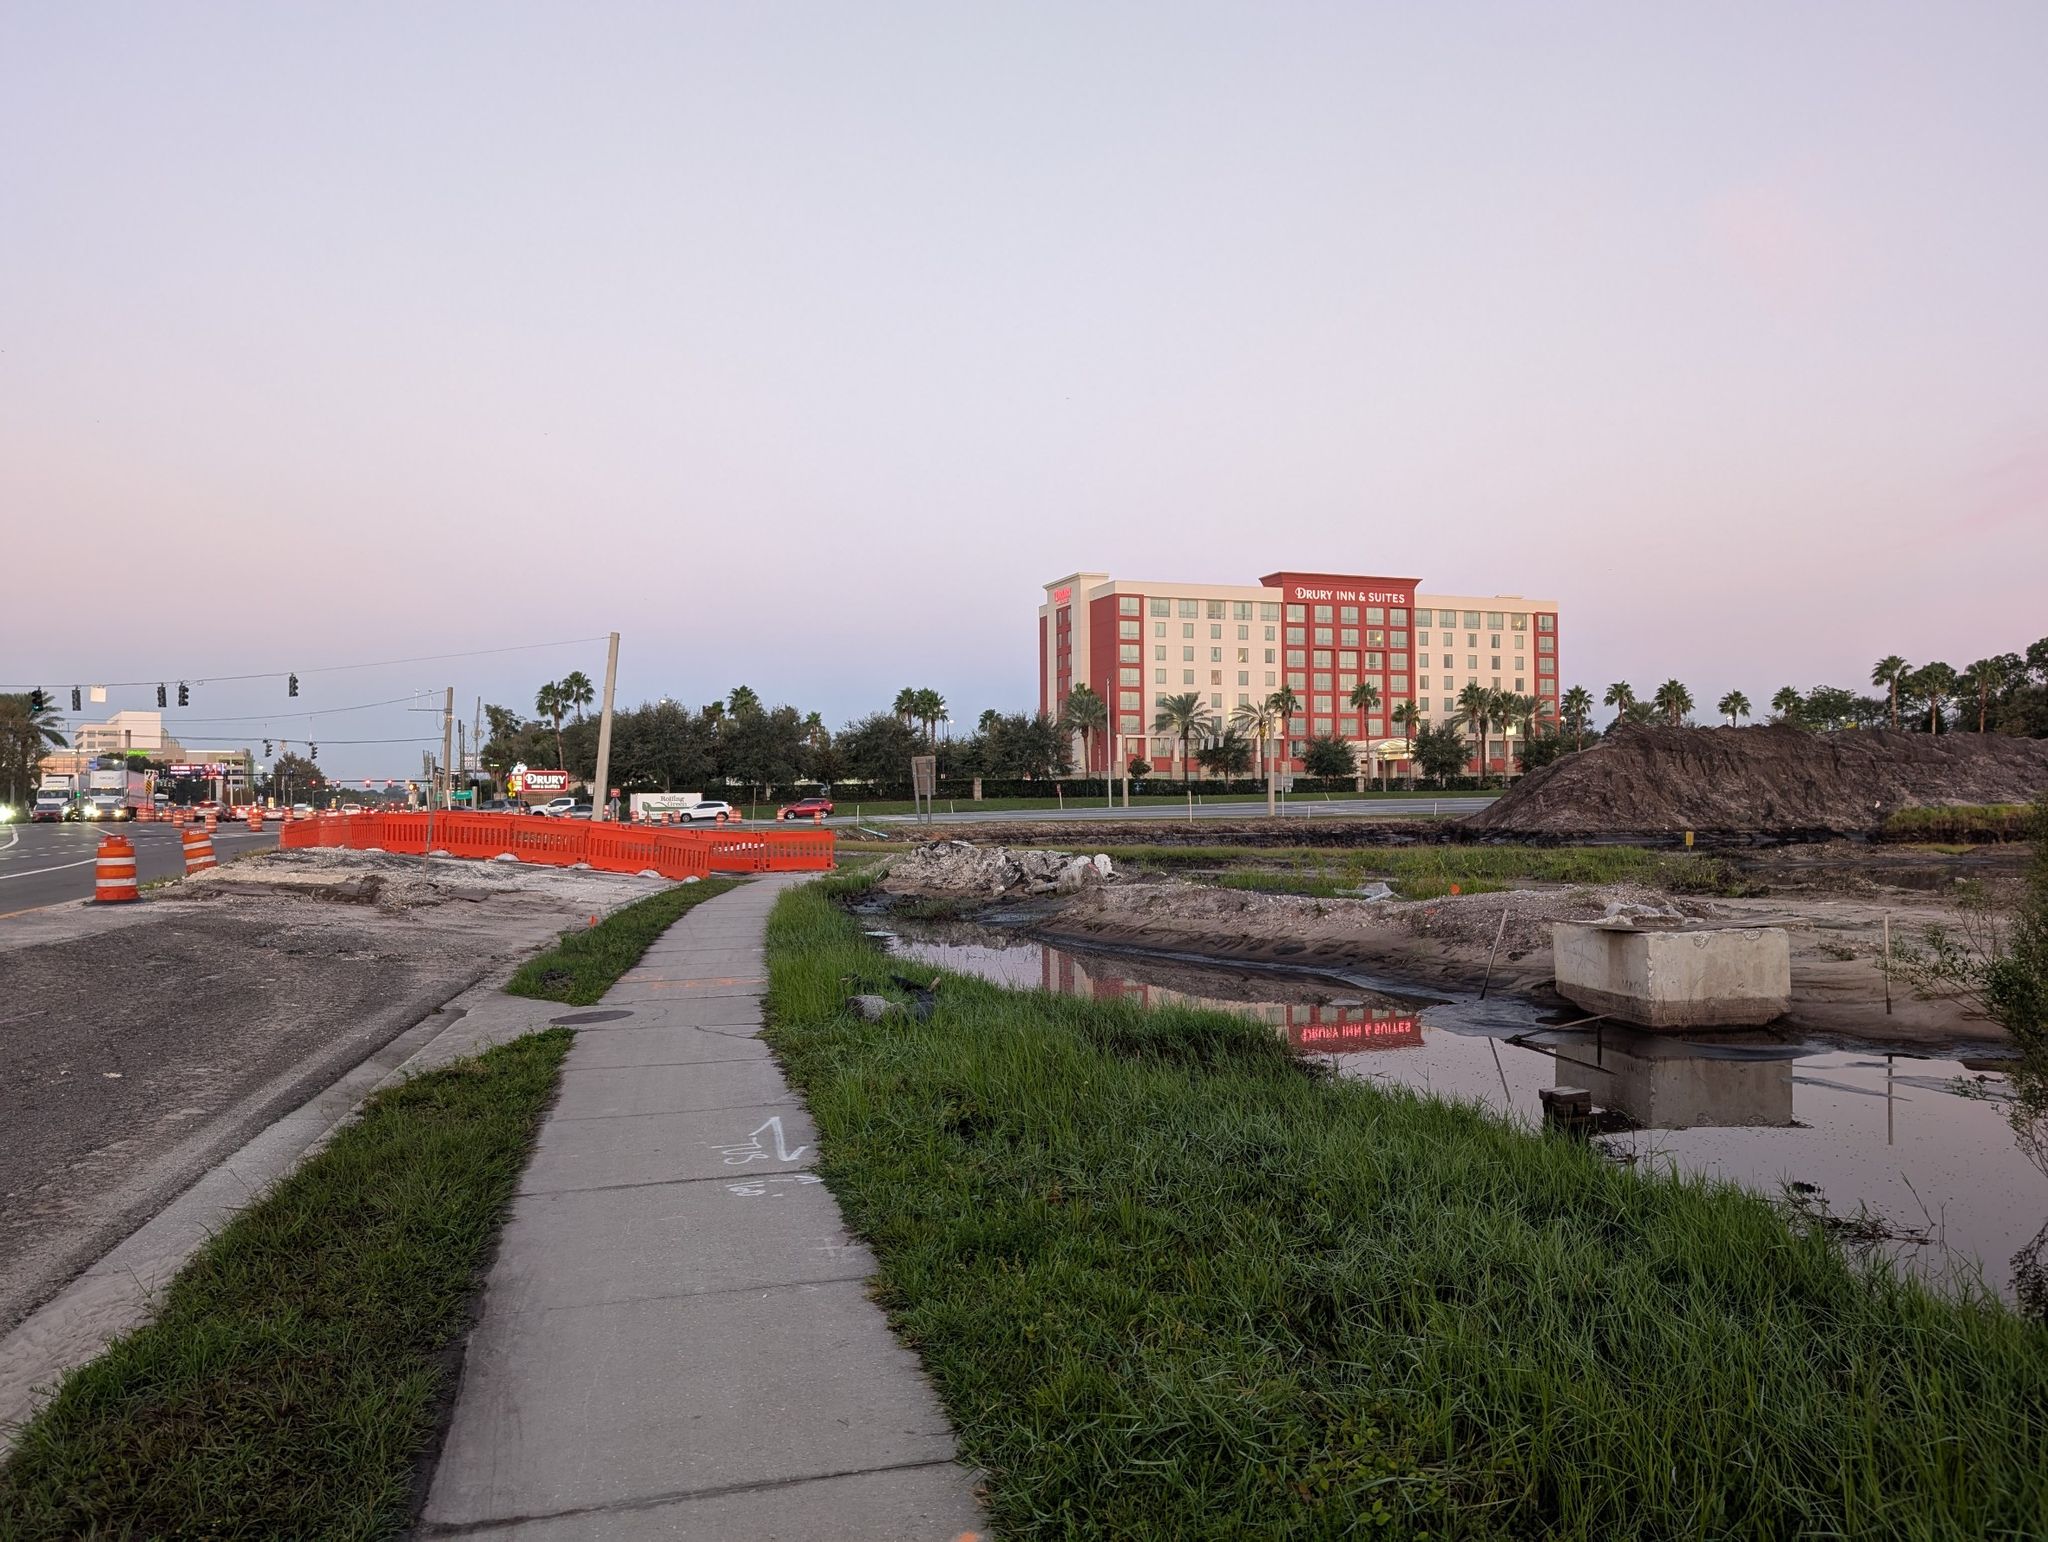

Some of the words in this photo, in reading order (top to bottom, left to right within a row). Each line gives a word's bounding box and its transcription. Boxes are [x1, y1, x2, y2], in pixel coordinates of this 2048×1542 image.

[1295, 587, 1333, 601] DRURY
[1336, 591, 1356, 601] INN
[1358, 592, 1366, 602] &
[1368, 592, 1405, 604] SUITES
[525, 773, 566, 785] DRURY
